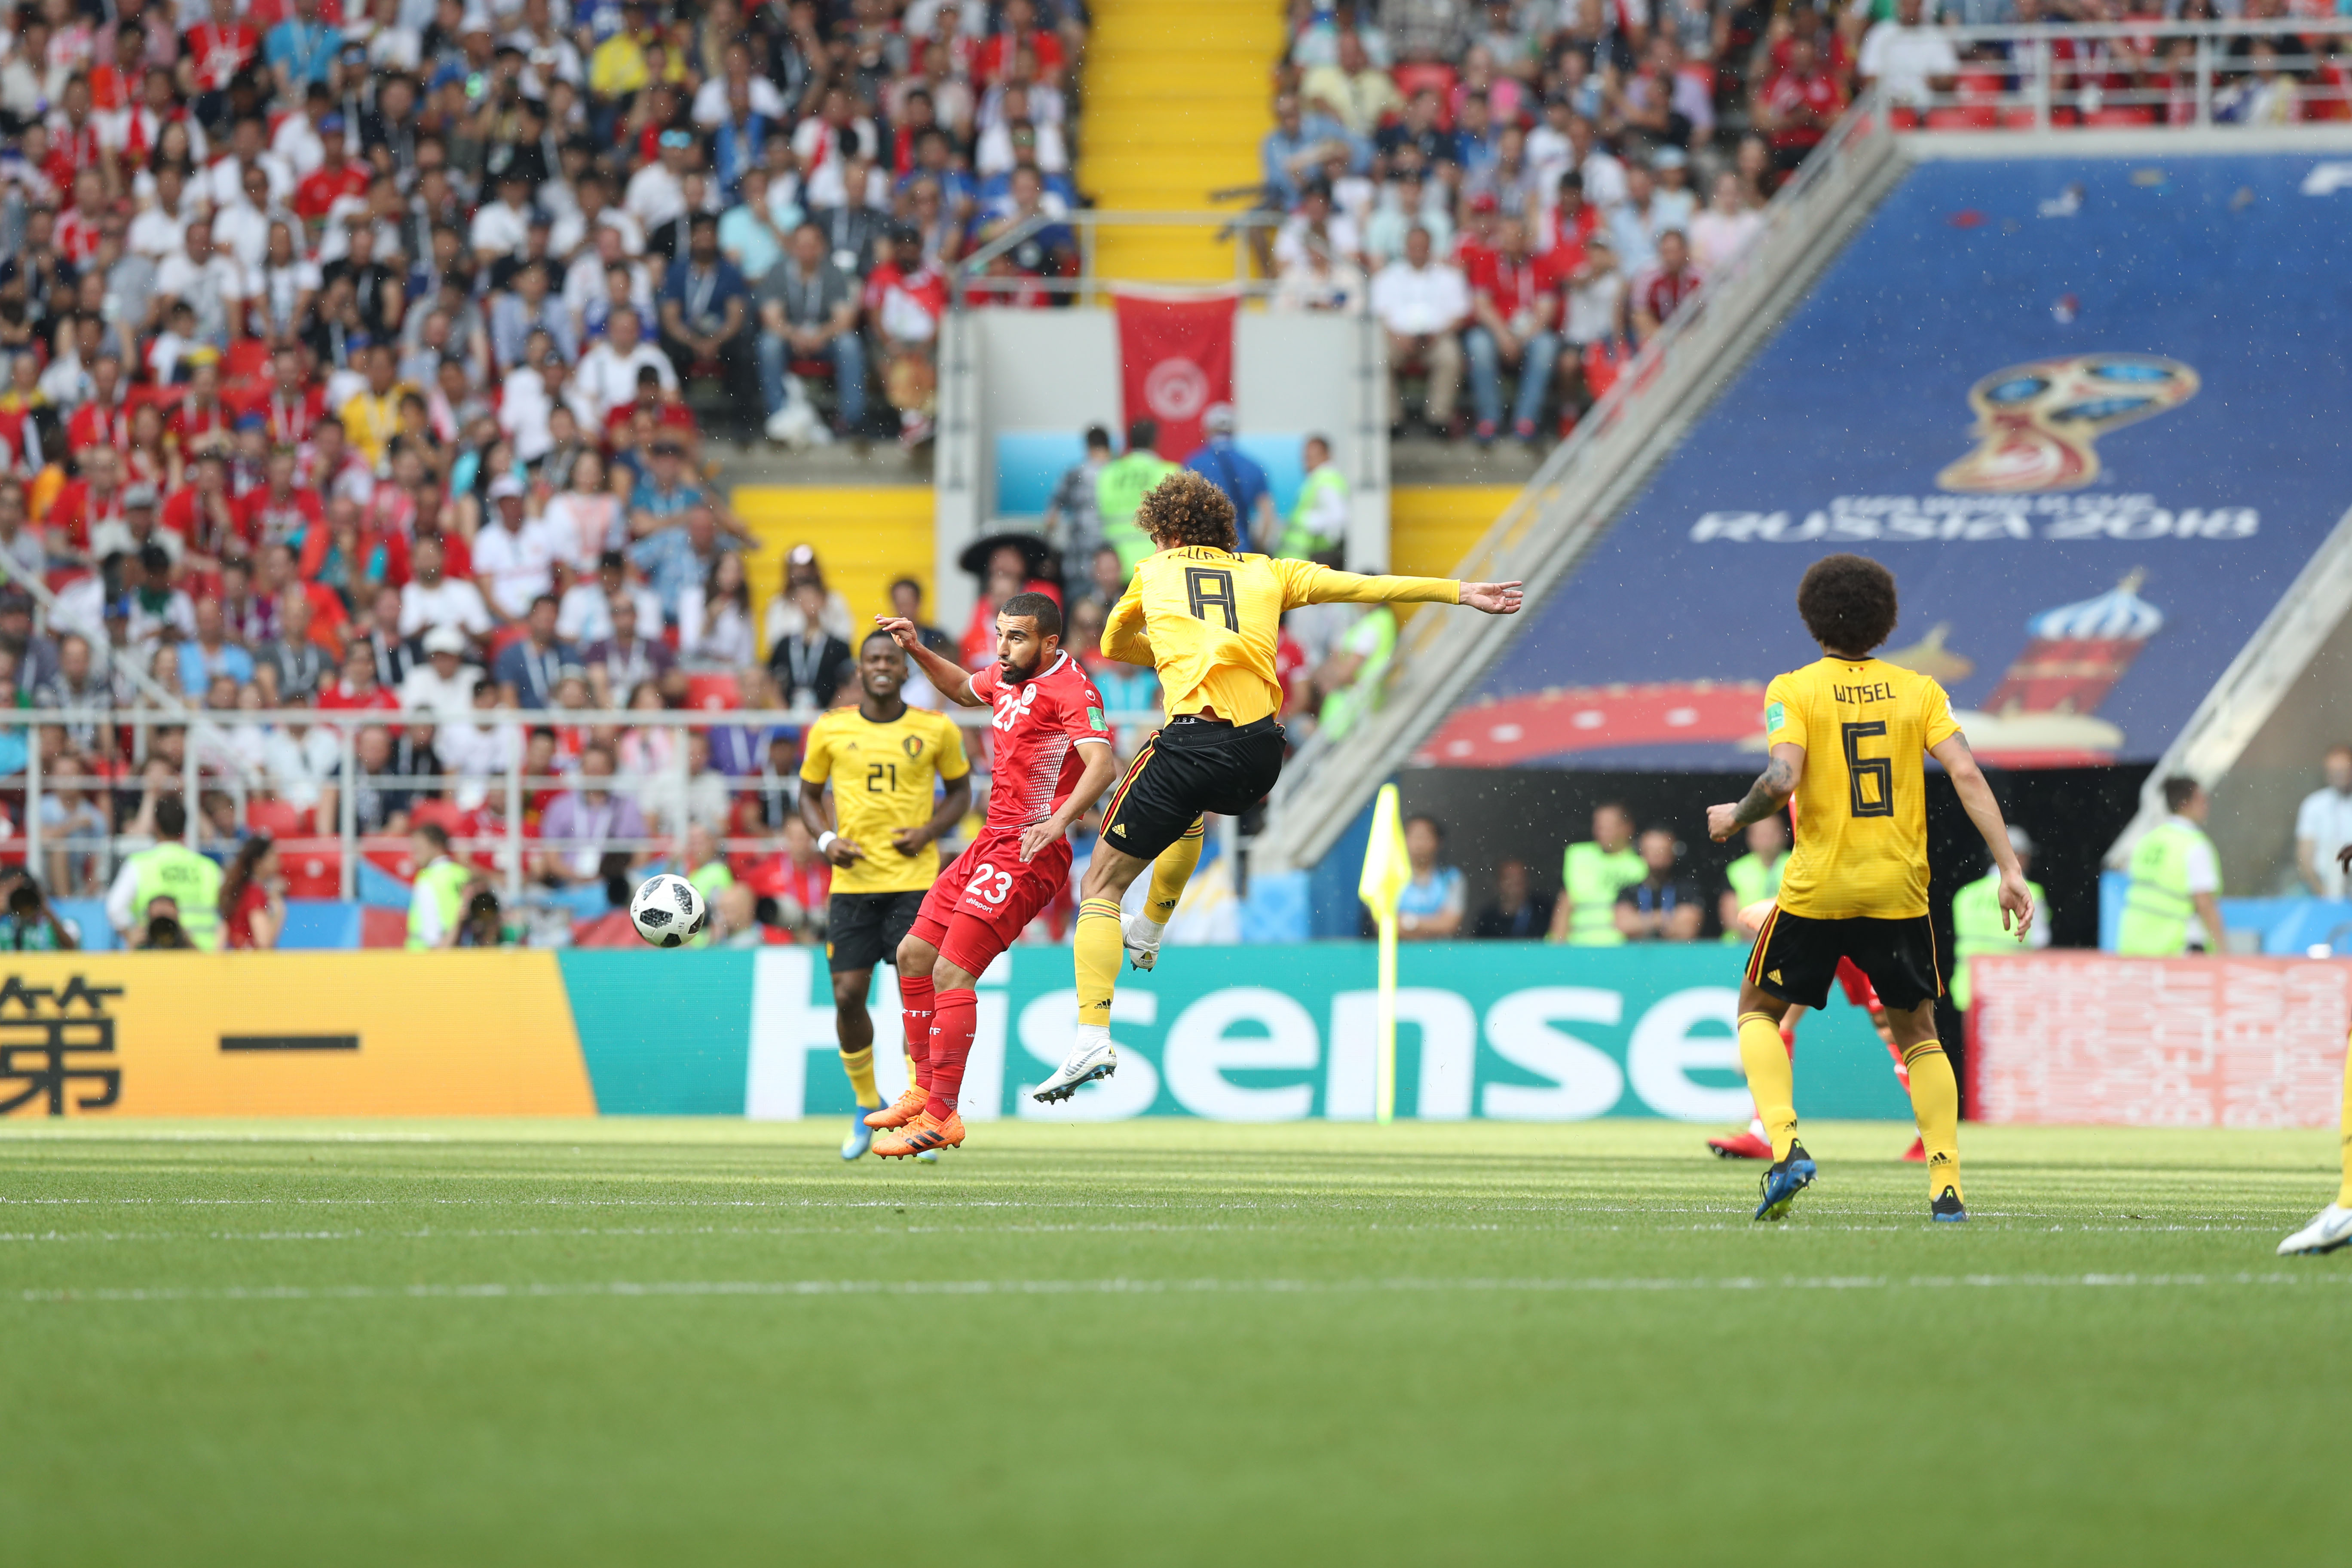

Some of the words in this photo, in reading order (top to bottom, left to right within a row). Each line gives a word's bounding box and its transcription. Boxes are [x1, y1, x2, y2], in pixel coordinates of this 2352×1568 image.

[1690, 510, 2032, 543] RUSSIA
[2043, 506, 2259, 540] 2018
[1834, 682, 1896, 704] WITSEL
[992, 694, 1020, 732] 23
[867, 763, 895, 791] 21
[1842, 721, 1894, 818] 6
[965, 863, 1013, 904] 23
[966, 897, 993, 913] uhlsport
[745, 947, 1756, 1123] Hisense
[929, 1026, 941, 1035] TF
